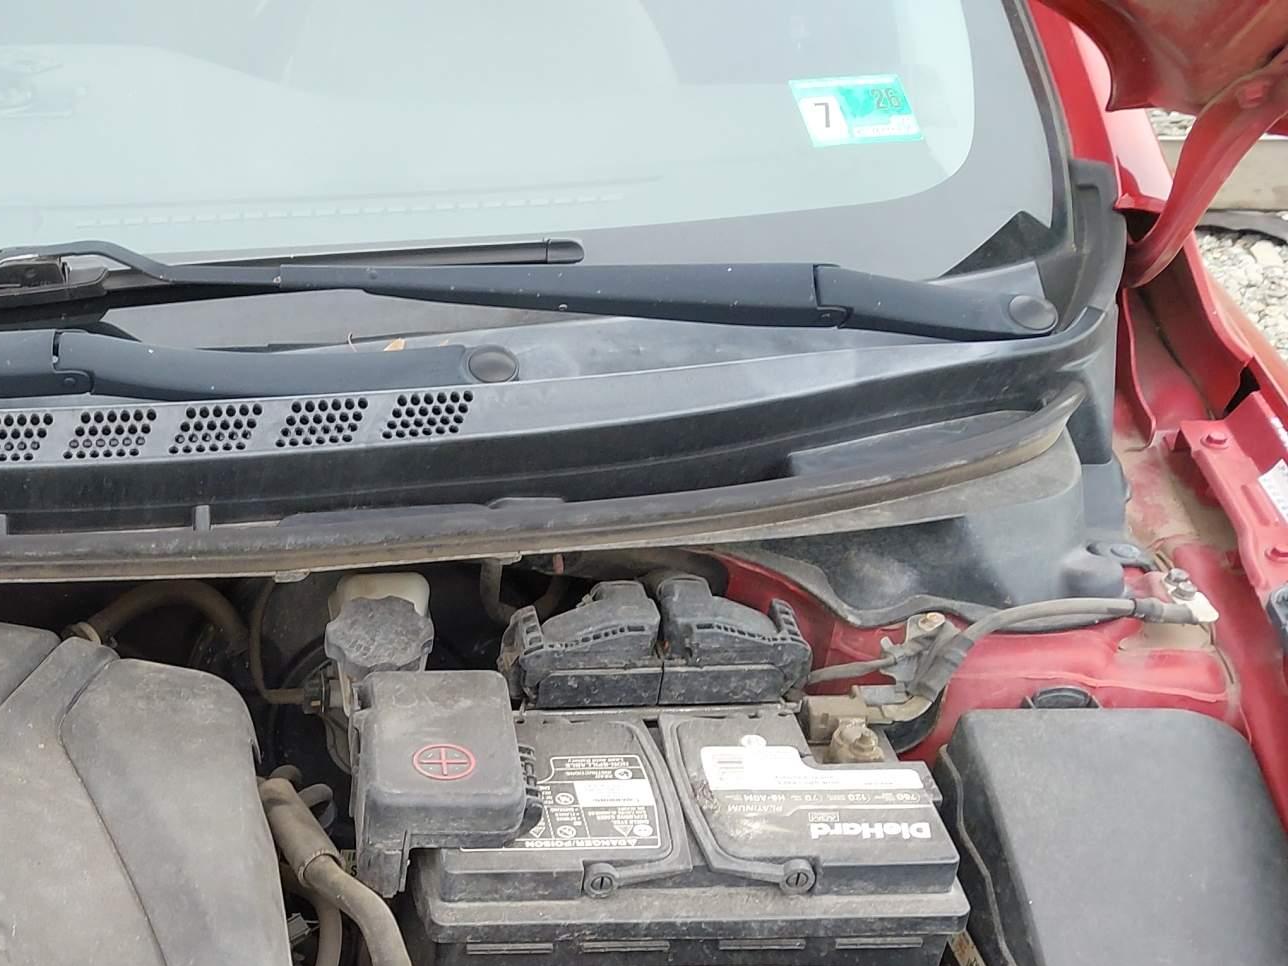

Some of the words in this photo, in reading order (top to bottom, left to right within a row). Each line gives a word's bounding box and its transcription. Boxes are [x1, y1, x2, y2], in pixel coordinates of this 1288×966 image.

[870, 87, 902, 110] 26
[813, 102, 831, 128] 7
[727, 803, 783, 813] PLATINUM
[810, 821, 932, 840] DieHard
